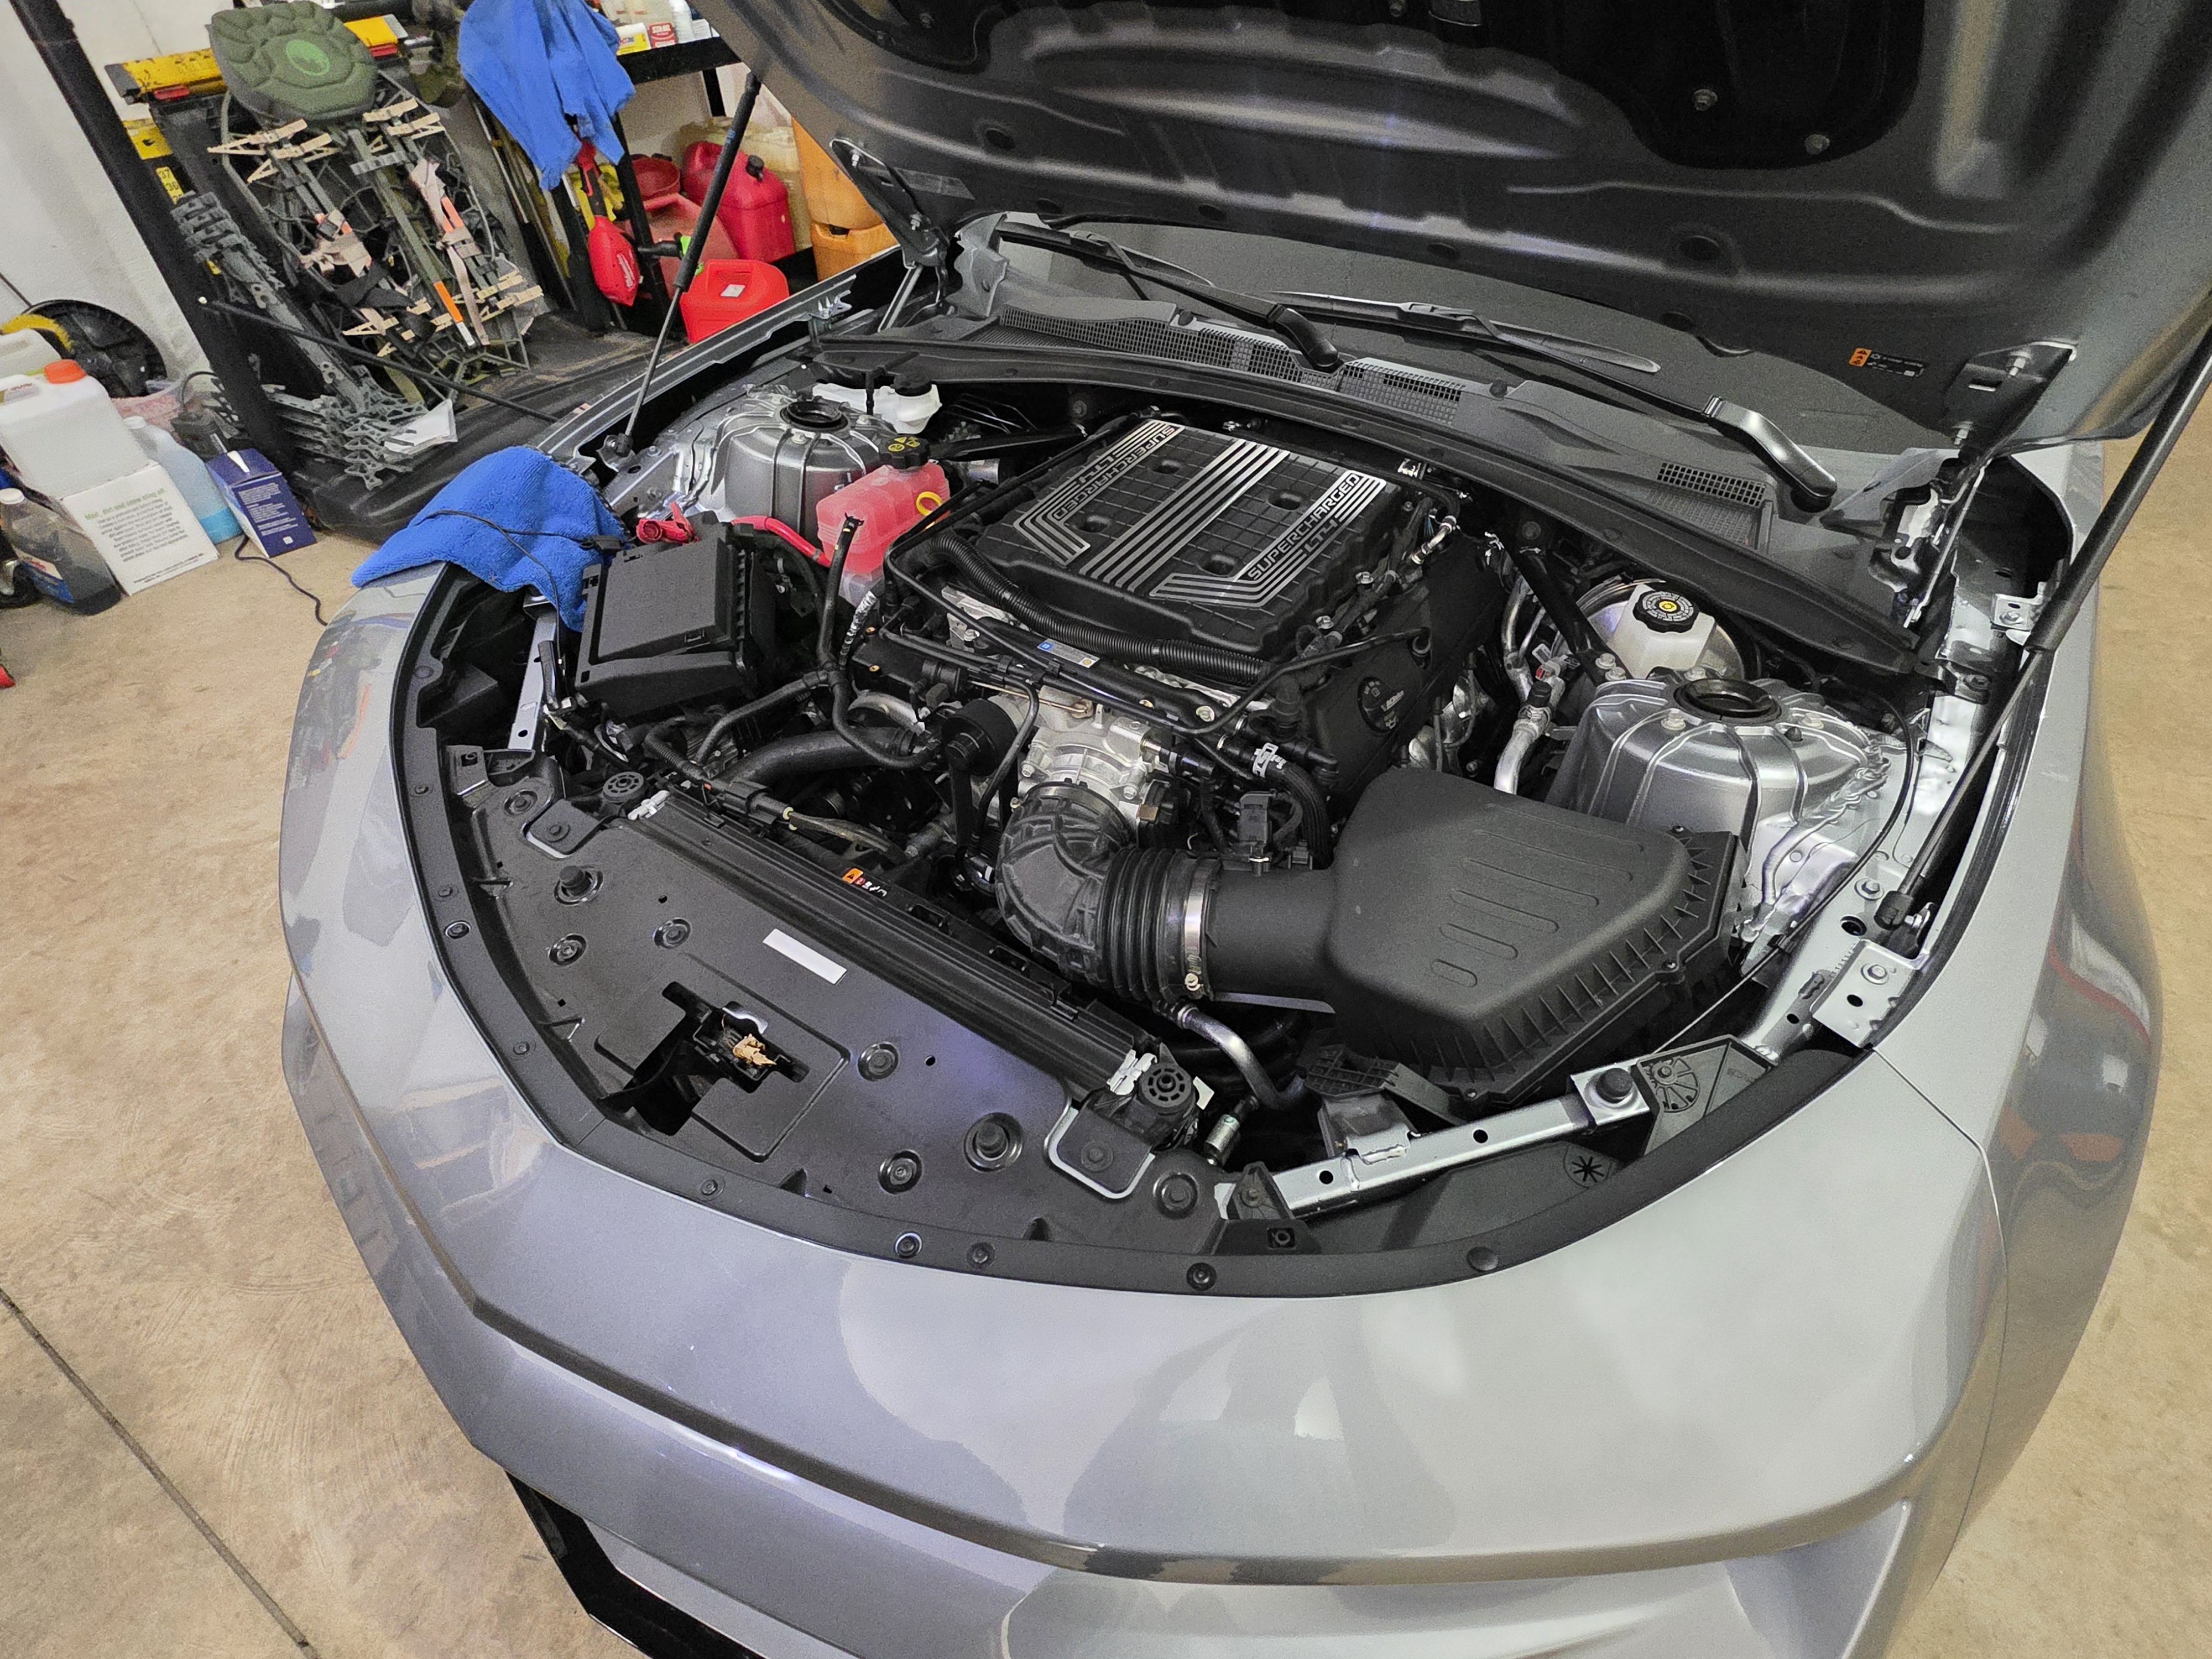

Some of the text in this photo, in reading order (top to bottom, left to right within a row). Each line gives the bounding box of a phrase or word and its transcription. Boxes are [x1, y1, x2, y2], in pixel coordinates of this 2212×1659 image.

[1053, 425, 1176, 520] SUPERCHARGED
[1078, 456, 1114, 483] LT4
[1247, 473, 1360, 580] SUPERCHARGED
[1303, 519, 1338, 552] LT4
